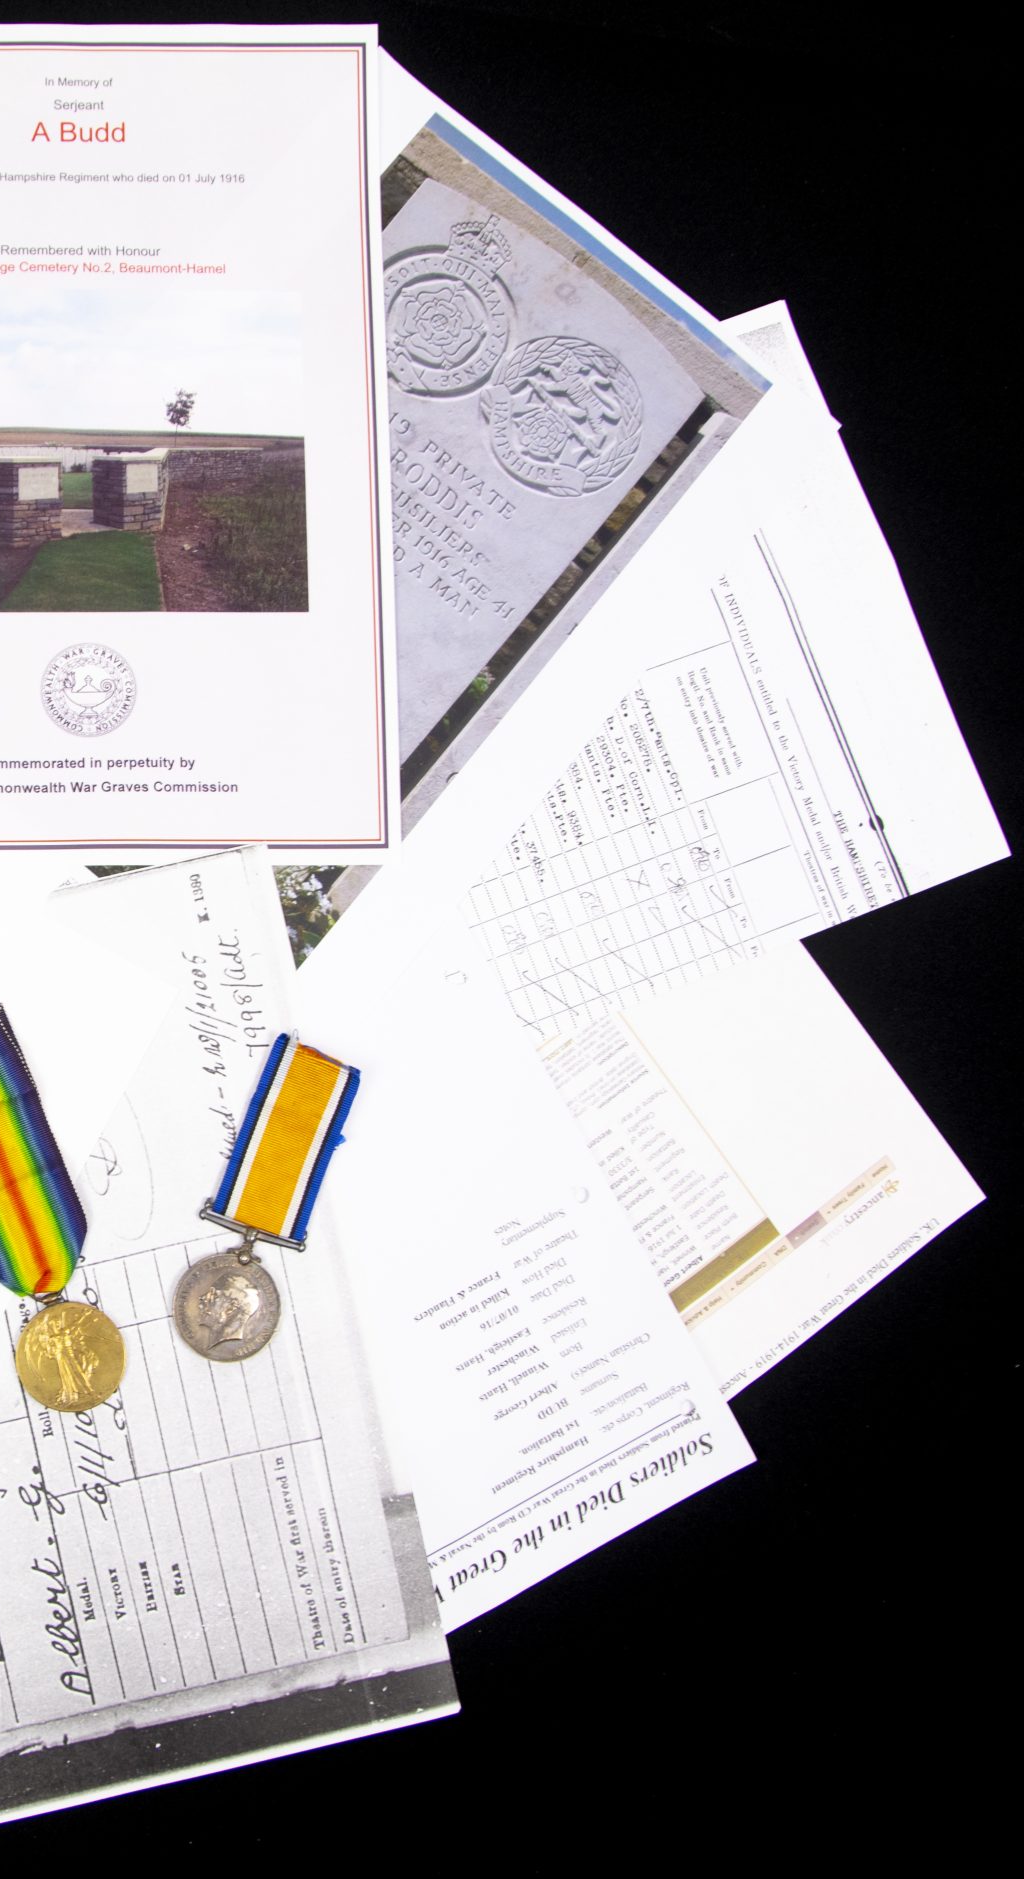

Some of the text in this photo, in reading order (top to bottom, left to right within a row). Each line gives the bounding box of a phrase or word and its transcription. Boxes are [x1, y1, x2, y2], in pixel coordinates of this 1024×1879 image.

[45, 77, 112, 88] In Memory of
[54, 100, 104, 110] Serjeant
[32, 122, 125, 142] A Budd
[0, 173, 55, 183] Hampshire
[60, 172, 108, 183] Regiment
[112, 174, 133, 182] who
[137, 174, 158, 182] died
[179, 174, 190, 182] 01
[195, 174, 215, 184] July
[220, 174, 244, 183] 1916
[1, 245, 160, 256] Remembered with Honour
[19, 262, 78, 274] Cemetery
[83, 262, 114, 274] No.2,
[120, 263, 225, 274] Beaumont-Hamel
[493, 401, 564, 481] HAMPSHIRE
[391, 448, 485, 531] RODDIS
[418, 439, 520, 521] PRIVATE
[409, 561, 479, 619] A MAN
[413, 535, 515, 620] 1916 AGE 41
[44, 647, 132, 732] COMMONWEALTH WAR GRAVES COMMISSION
[90, 758, 101, 768] in
[107, 756, 174, 770] perpetuity
[180, 757, 194, 770] by
[723, 593, 849, 900] INDIVIDUALS entitled to the Victory Medal and/or British
[70, 782, 96, 792] War
[102, 781, 148, 793] Graves
[154, 781, 238, 793] Commission
[595, 735, 629, 813] 29304. Pte.
[189, 873, 205, 901] 1380
[413, 1271, 500, 1322] France & Flanders
[439, 1287, 510, 1331] Killed in action
[755, 1217, 940, 1368] UK, Soldiers Died in the Great War, 1914-1919
[479, 1304, 519, 1330] 01/07/16
[487, 1344, 540, 1377] Winchester
[493, 1382, 558, 1421] Albert George
[537, 1397, 568, 1420] BUDD
[518, 1419, 580, 1456] 1st Battalion.
[491, 1435, 589, 1495] Hampshire Regiment
[448, 1432, 714, 1593] Soldiers Died in the Great
[273, 1456, 326, 1650] Theatre of War first served in
[316, 1507, 355, 1643] Date of entry therein
[76, 1577, 96, 1621] Medal.
[107, 1568, 127, 1619] VICTORY
